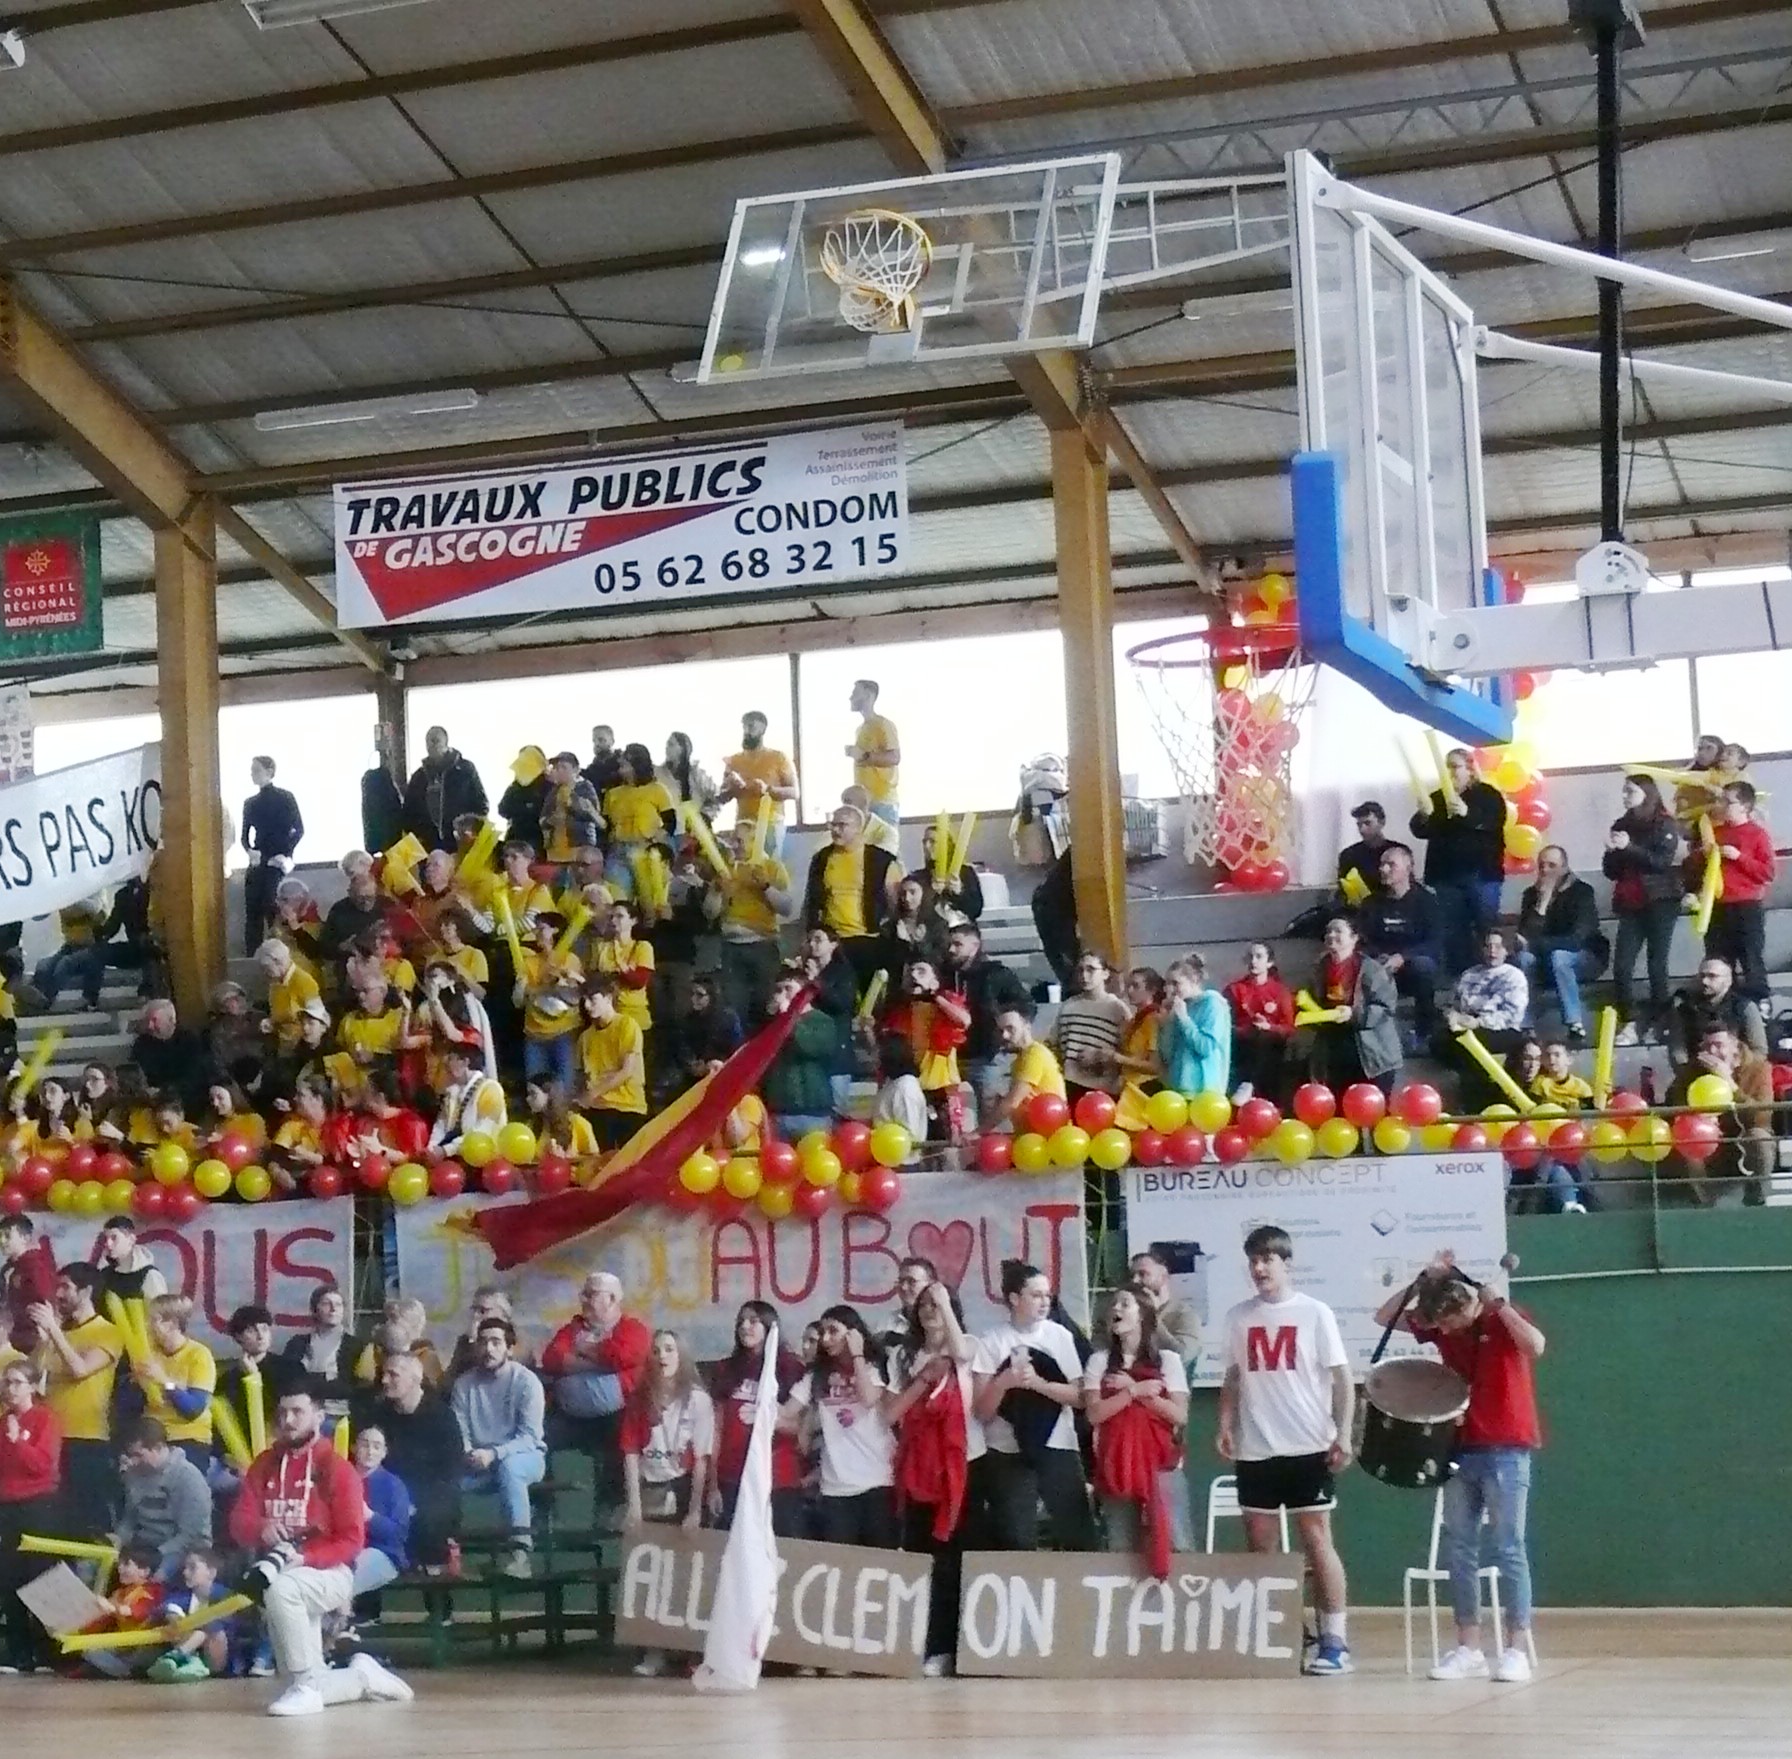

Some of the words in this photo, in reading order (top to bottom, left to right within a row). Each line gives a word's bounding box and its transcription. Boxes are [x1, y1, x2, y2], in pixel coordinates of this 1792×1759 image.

[805, 456, 897, 475] Assainissement
[817, 442, 898, 461] Terrassement
[347, 481, 548, 536] TRAVAUX
[567, 456, 767, 515] PUBLICS
[831, 470, 898, 486] Démolition
[735, 490, 899, 536] CONDOM
[353, 540, 379, 559] DE
[384, 521, 588, 570] GASCOGNE
[594, 560, 641, 594] 05
[657, 554, 705, 588] 62
[721, 548, 770, 581] 68
[786, 540, 833, 575] 32
[851, 532, 898, 567] 15
[3, 582, 76, 598] CONSEIL
[3, 597, 76, 613] RÉGIONAL
[39, 797, 114, 878] PAS
[121, 779, 162, 856] KO
[1144, 1169, 1247, 1192] BUREAU
[1255, 1162, 1388, 1188] CONCEPT
[1435, 1161, 1486, 1175] xerox
[1247, 1325, 1298, 1373] M
[793, 1563, 932, 1656] CLEM
[962, 1574, 1057, 1659] ON
